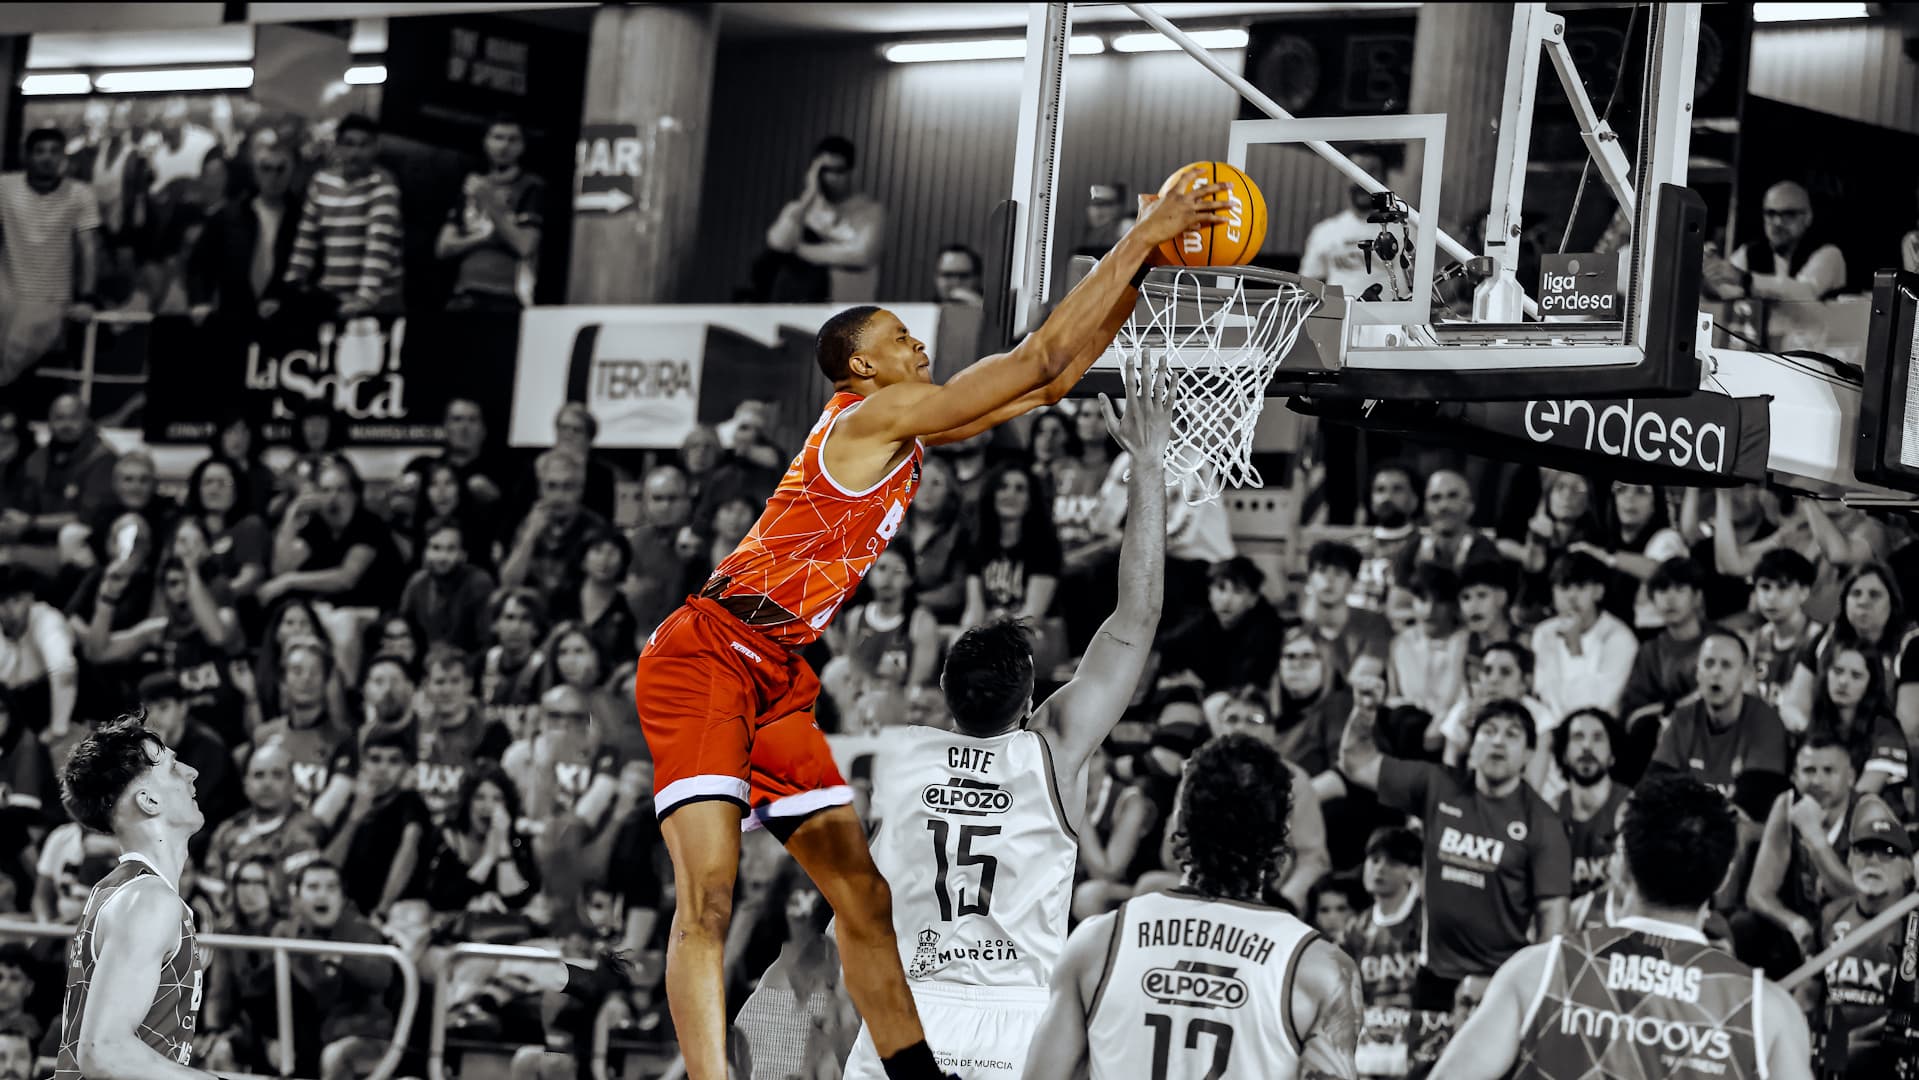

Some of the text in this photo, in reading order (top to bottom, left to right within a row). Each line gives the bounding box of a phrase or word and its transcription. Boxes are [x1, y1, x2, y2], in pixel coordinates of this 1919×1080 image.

[1542, 291, 1613, 310] endesa
[1543, 272, 1575, 293] liga
[1524, 398, 1726, 473] endesa
[1440, 826, 1505, 865] BAXI
[927, 819, 1002, 922] 15
[938, 948, 1018, 964] MURCIA
[1138, 918, 1276, 965] RADEBAUGH
[1607, 953, 1704, 1004] BASSAS
[1144, 1013, 1234, 1080] 12
[1560, 998, 1732, 1059] inmoovs
[960, 1059, 972, 1067] DE
[974, 1059, 1013, 1070] MURCIA
